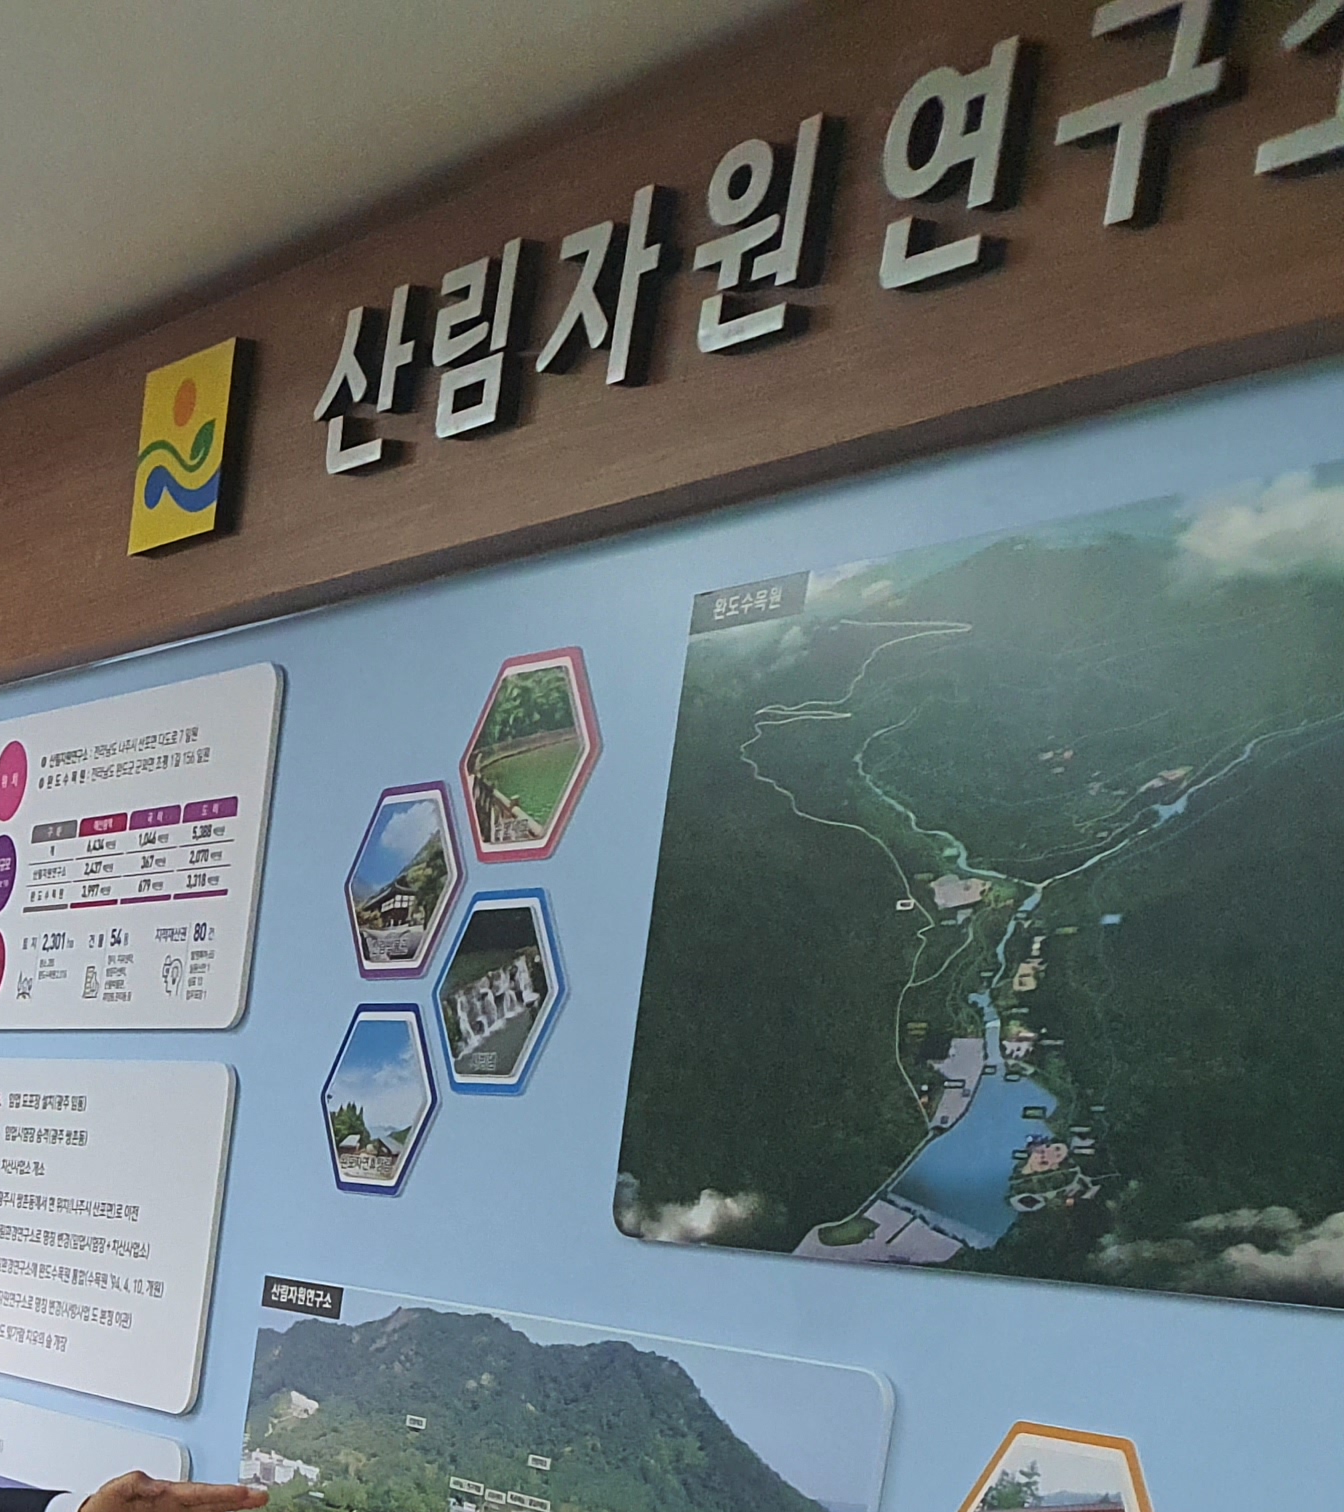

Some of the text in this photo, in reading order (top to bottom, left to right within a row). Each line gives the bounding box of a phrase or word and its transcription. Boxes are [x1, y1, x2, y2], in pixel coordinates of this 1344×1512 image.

[713, 586, 782, 621] 완도수목원
[138, 879, 151, 892] 679
[42, 932, 66, 952] 2,301
[110, 929, 122, 946] 54
[193, 923, 206, 941] 80
[271, 1284, 332, 1308] 산림자원연구소
